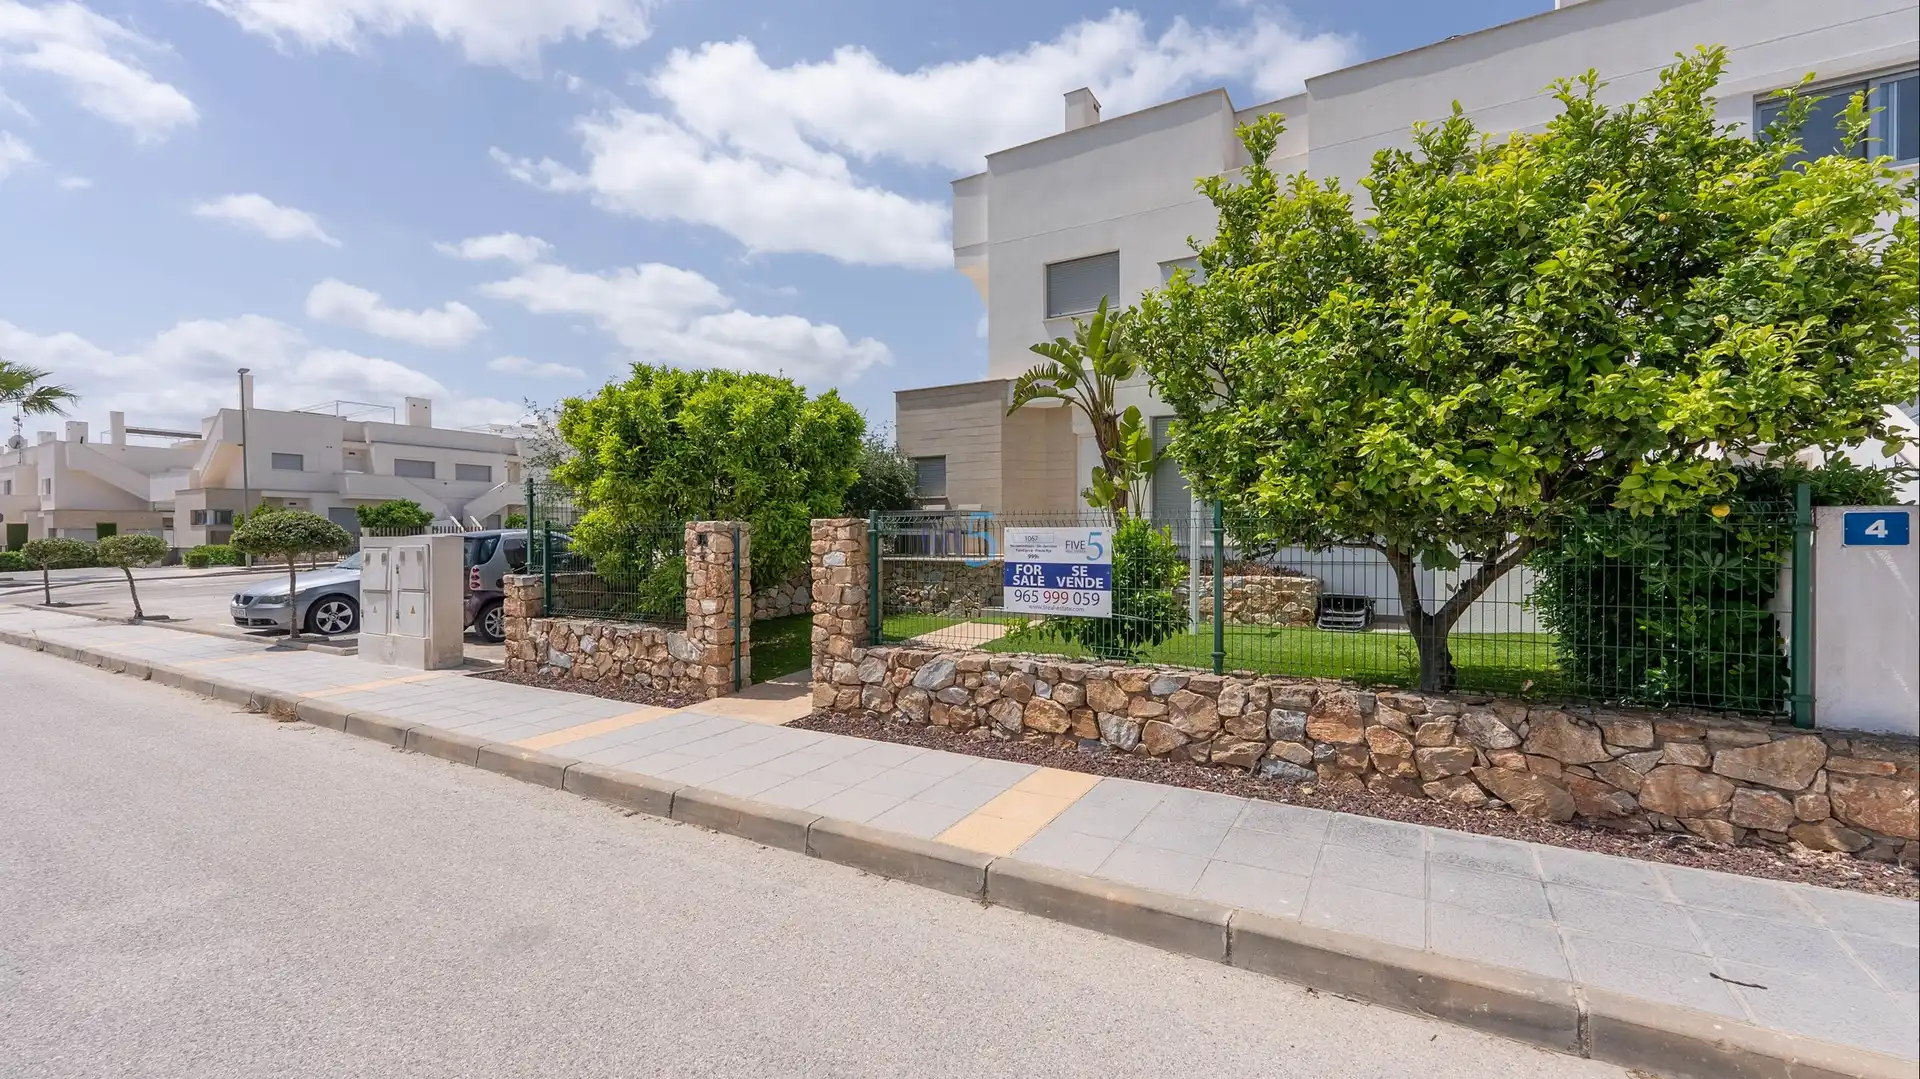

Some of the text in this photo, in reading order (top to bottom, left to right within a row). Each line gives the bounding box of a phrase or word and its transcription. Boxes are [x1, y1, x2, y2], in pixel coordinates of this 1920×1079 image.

[1864, 519, 1889, 538] 4
[1065, 531, 1104, 561] FIVE 5
[1015, 564, 1042, 576] FOR
[1071, 565, 1088, 577] SE
[1012, 575, 1045, 587] SALE
[1056, 576, 1104, 589] VENDE
[1014, 589, 1100, 606] 965 999 059
